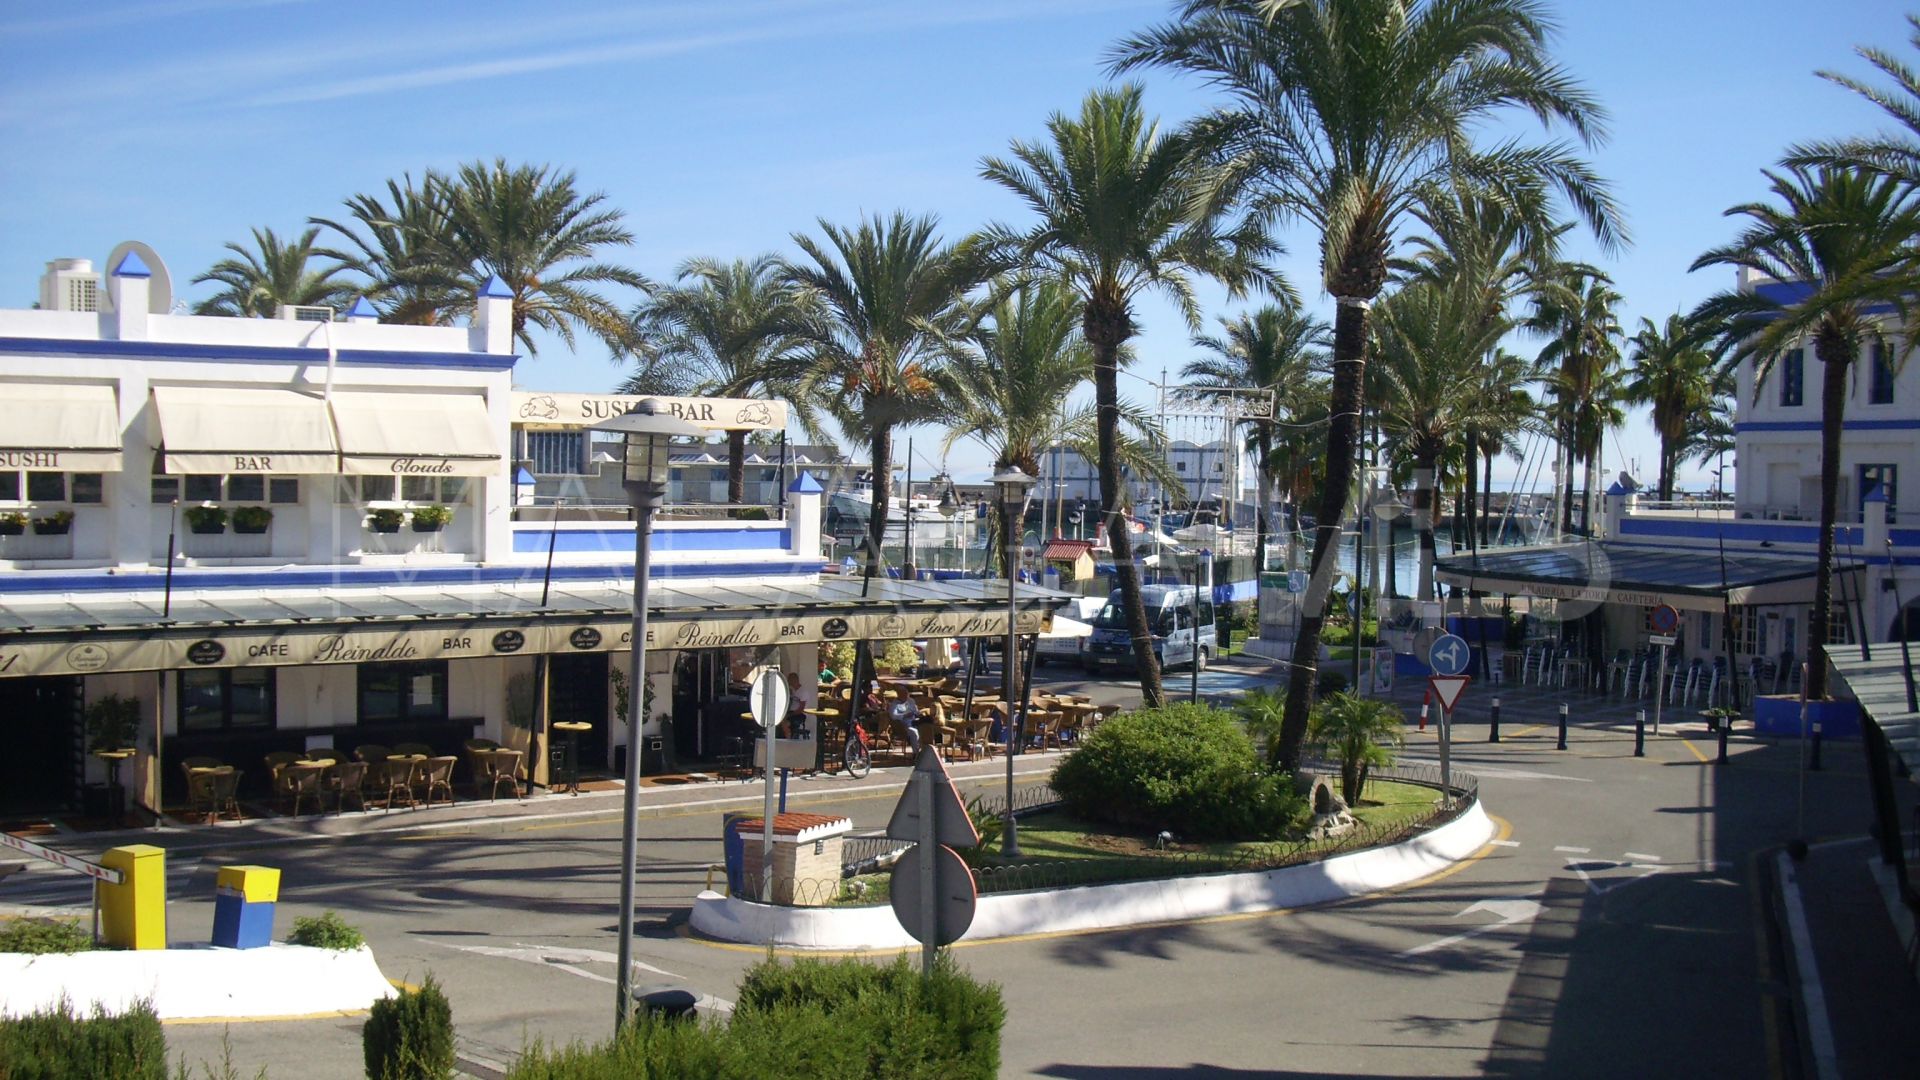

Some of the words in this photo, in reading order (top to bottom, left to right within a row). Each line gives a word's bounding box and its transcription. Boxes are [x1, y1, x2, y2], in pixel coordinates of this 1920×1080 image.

[581, 400, 638, 418] SUS
[669, 402, 716, 421] BAR
[234, 456, 273, 471] BAR
[390, 457, 454, 474] Clouds
[620, 630, 655, 643] CE
[675, 622, 760, 647] Reinaldo
[781, 624, 805, 637] BAR
[915, 616, 956, 635] Since
[959, 617, 1002, 634] 1981
[248, 644, 289, 658] CAFE
[313, 635, 418, 662] Reinaldo
[442, 637, 472, 650] BAR
